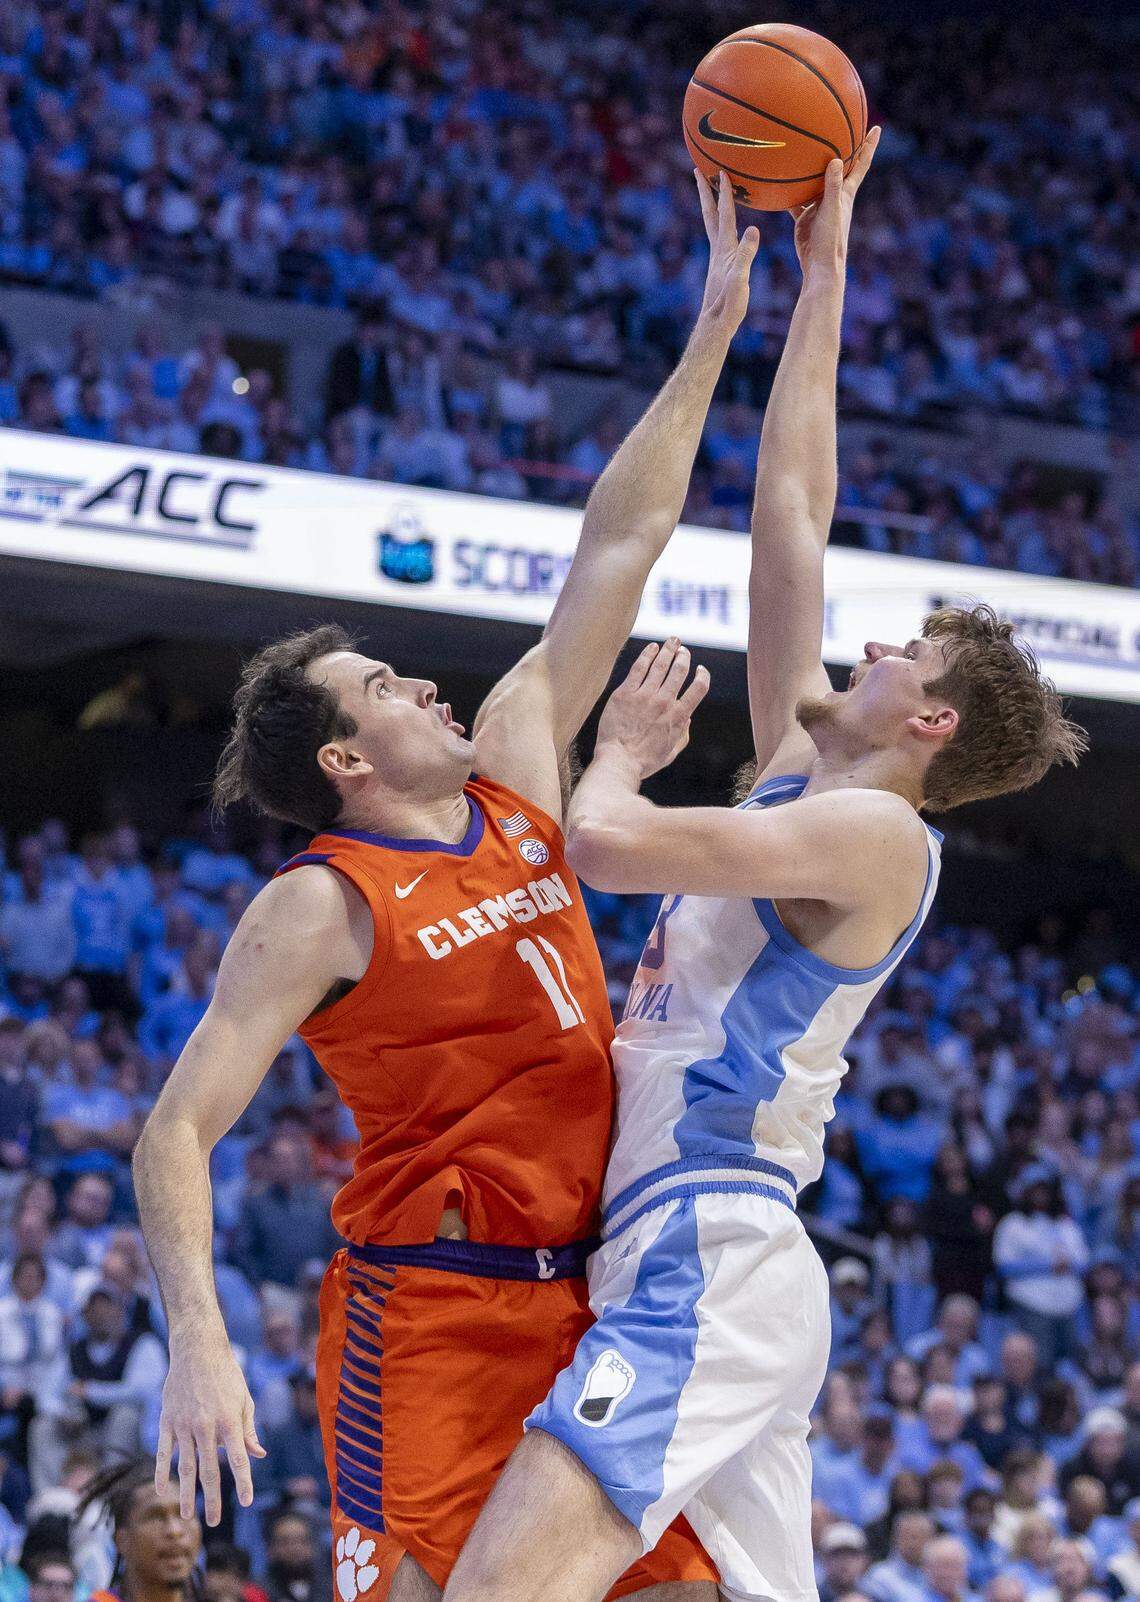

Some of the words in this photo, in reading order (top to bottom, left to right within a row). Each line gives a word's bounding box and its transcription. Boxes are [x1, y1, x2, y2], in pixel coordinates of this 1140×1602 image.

[80, 466, 263, 532] ACC
[416, 872, 573, 960] CLEMSON
[535, 1248, 556, 1280] C
